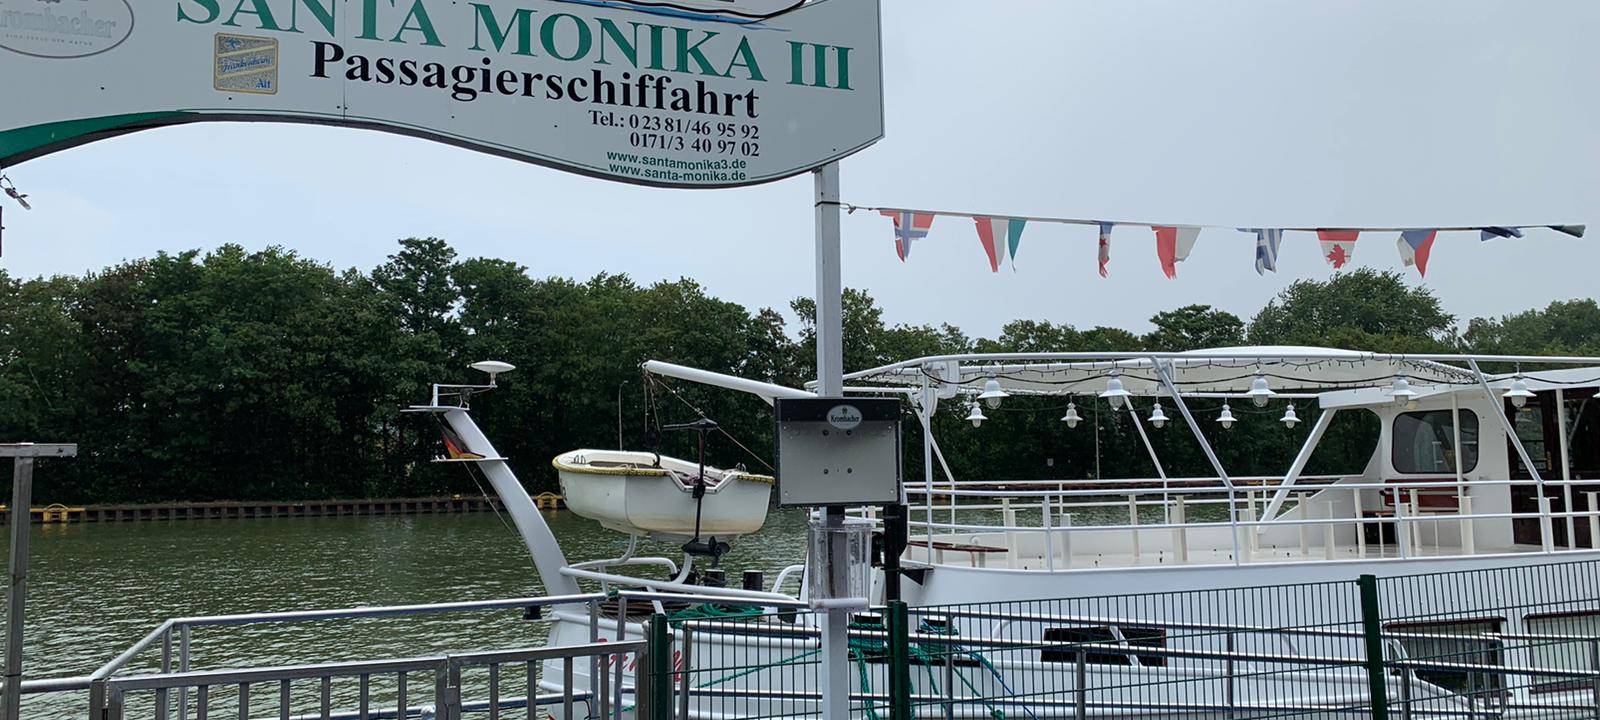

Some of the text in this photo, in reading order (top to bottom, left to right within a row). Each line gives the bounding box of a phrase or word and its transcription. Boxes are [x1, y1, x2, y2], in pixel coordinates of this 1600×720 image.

[0, 7, 117, 38] rombacher
[467, 3, 768, 82] MONIKA
[785, 40, 854, 90] III
[309, 40, 759, 119] Passagierschiffahrt
[588, 109, 625, 128] Tel.:
[717, 122, 736, 138] 95
[741, 124, 760, 140] 92
[629, 131, 760, 157] 0171/3 40 97 02
[606, 151, 747, 171] www.santamonika3.de
[609, 162, 747, 182] www.santa-monika.de
